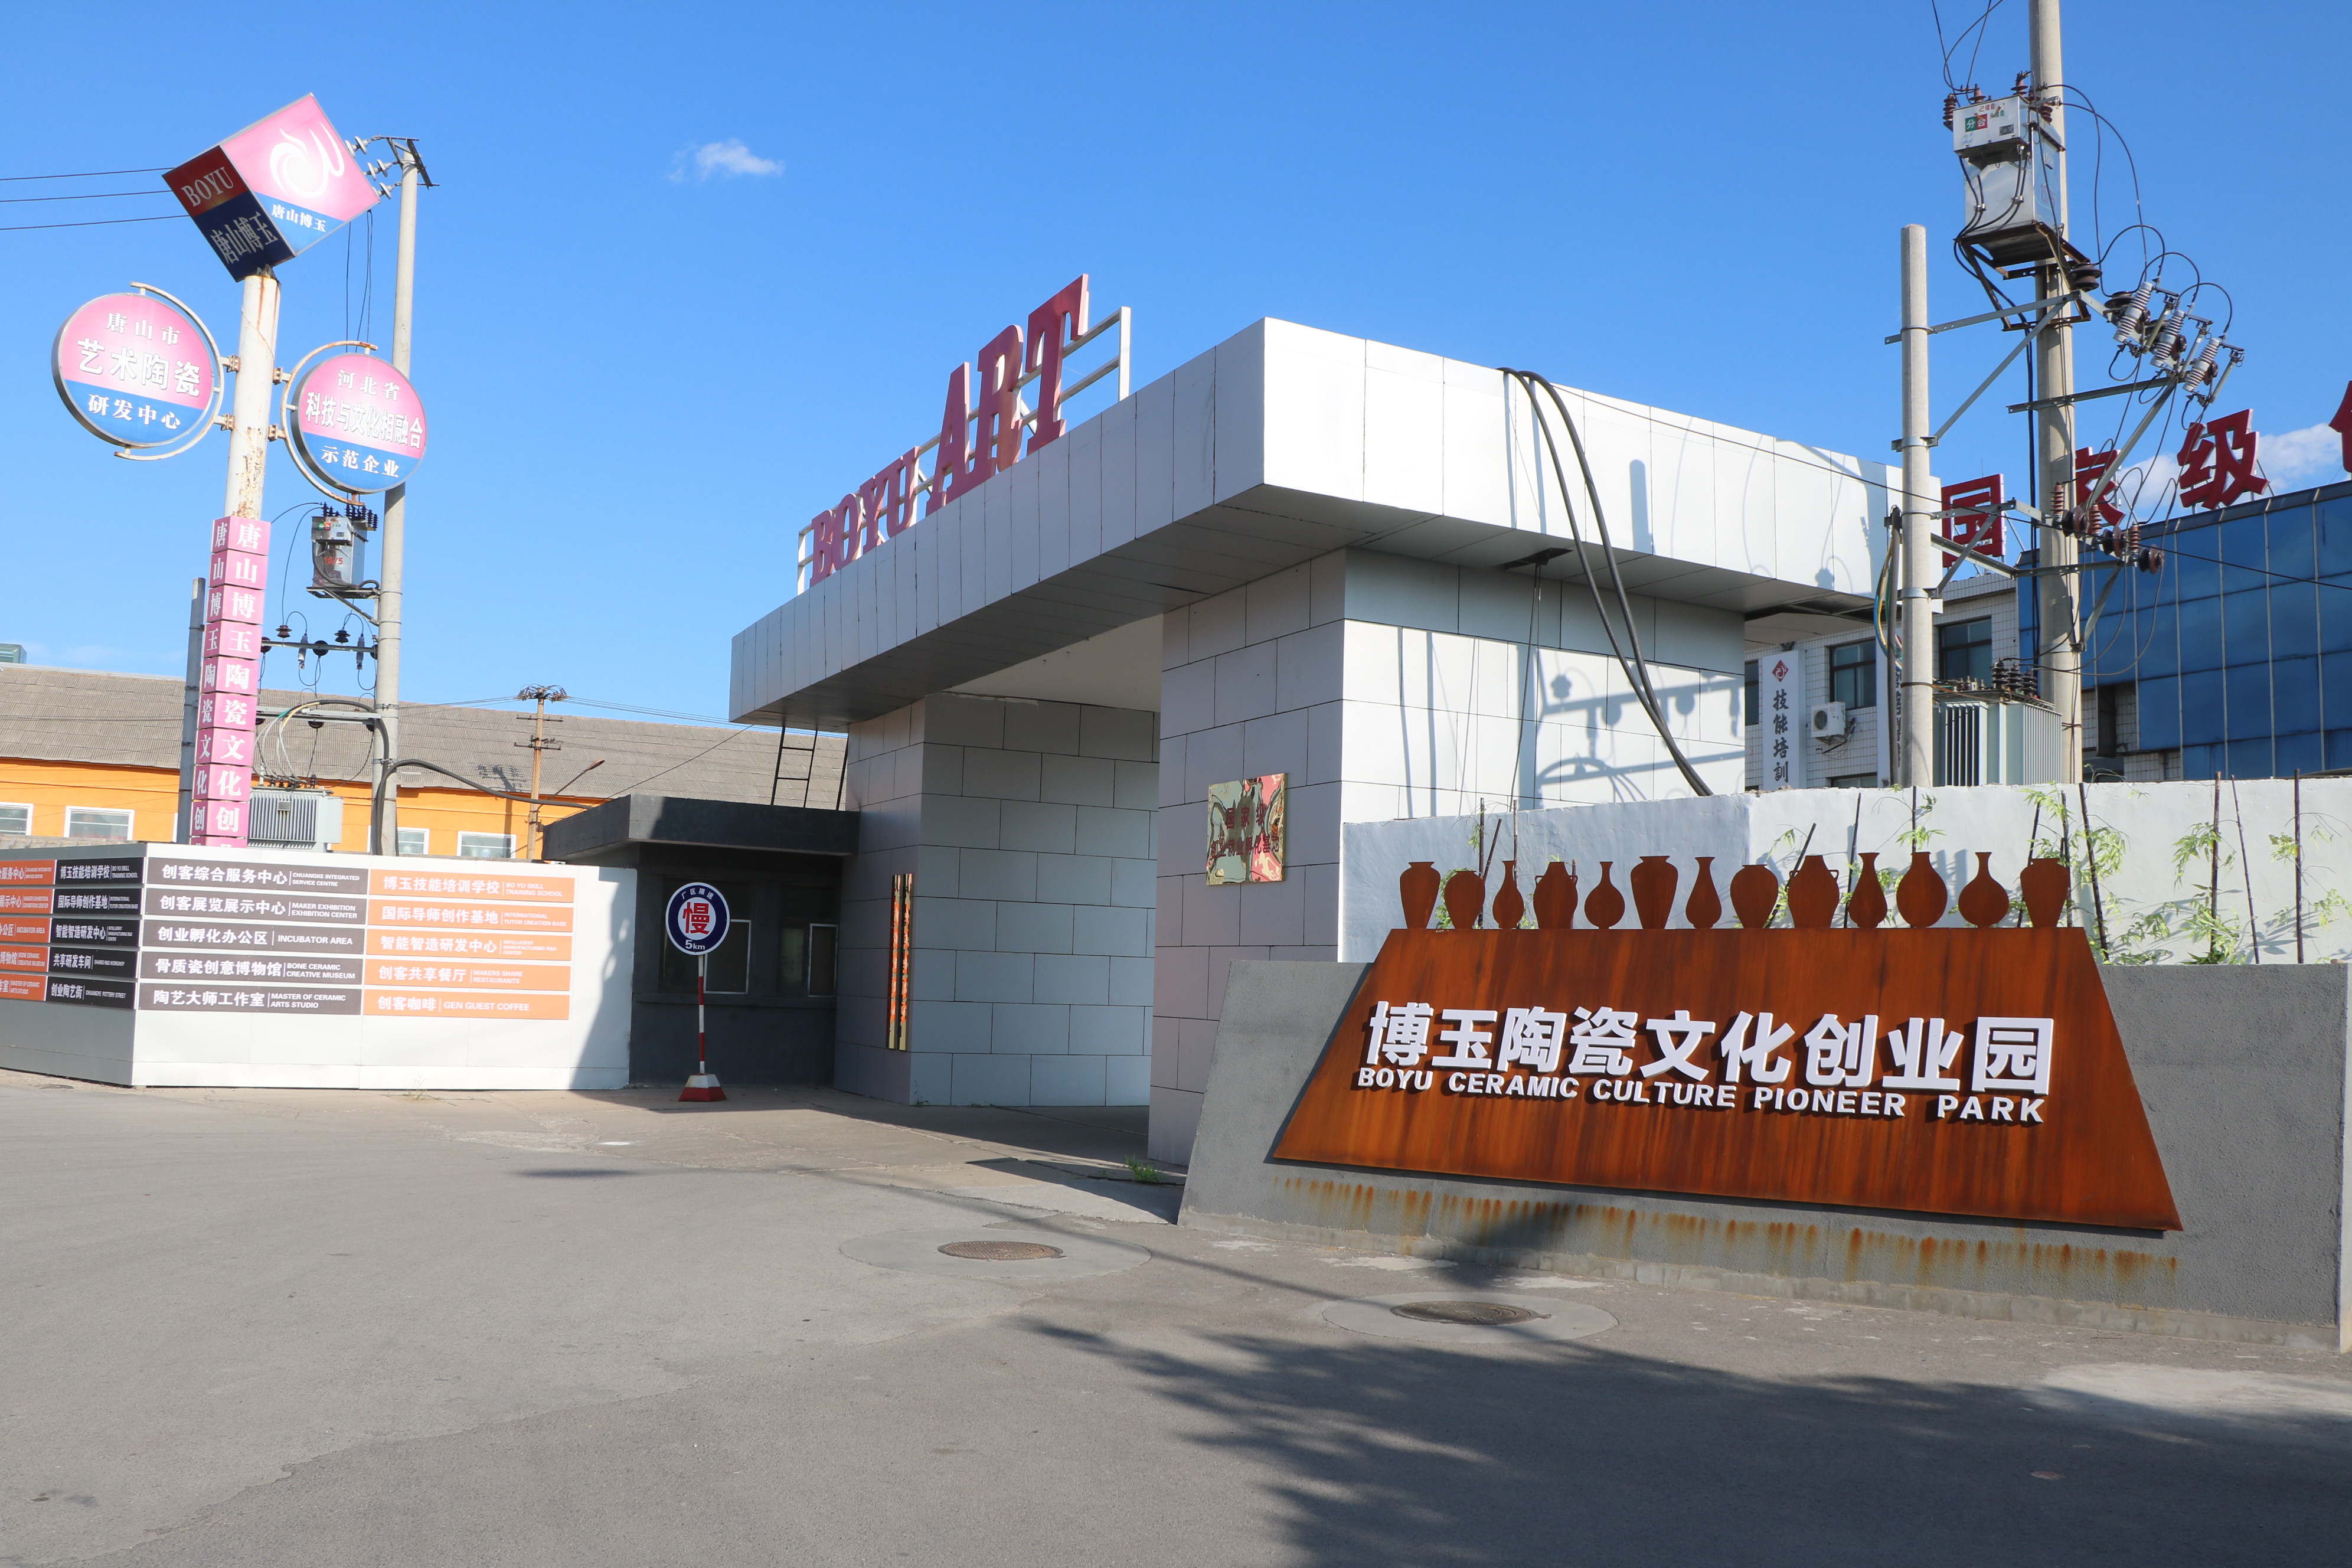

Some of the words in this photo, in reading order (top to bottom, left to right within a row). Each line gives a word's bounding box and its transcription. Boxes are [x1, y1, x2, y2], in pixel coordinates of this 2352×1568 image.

[181, 166, 235, 207] BOYU
[271, 204, 327, 233] 唐山博玉
[210, 212, 278, 265] 唐山博玉
[106, 312, 181, 346] 唐山市
[77, 338, 201, 397] 艺术陶瓷
[338, 369, 400, 401] 河北省
[88, 394, 181, 430] 研发中心
[305, 390, 423, 450] 科技与文化相融合
[810, 446, 920, 587] BOYU
[926, 274, 1089, 517] ART
[321, 445, 400, 478] 示范企业
[194, 522, 227, 845] 唐山博玉陶瓷文化创
[215, 523, 262, 847] 唐山博玉陶瓷文化创
[1226, 803, 1266, 829] 国家级
[1211, 833, 1279, 860] 创业就业孵化基地
[60, 865, 110, 879] 博玉技能培训学校
[162, 864, 288, 885] 创客综合服务中心
[383, 876, 500, 894] 博玉技能培训学校
[681, 888, 714, 899] 厂区限速
[58, 894, 108, 909] 国际导师创作基地
[160, 895, 286, 915] 创客展览展示中心
[382, 906, 499, 924] 国际导师创作基地
[682, 902, 710, 935] 慢
[0, 923, 14, 936] 公区
[55, 924, 106, 940] 智能智造研发中心
[158, 926, 268, 945] 创业孵化办公区
[277, 935, 328, 944] INCUBATOR
[380, 935, 497, 953] 智能智造研发中心
[685, 940, 705, 950] 5km
[54, 953, 92, 969] 共享研发车间
[156, 958, 282, 977] 骨质瓷创意博物馆
[378, 966, 466, 982] 创客共享餐厅
[51, 983, 83, 999] 创业陶艺街
[153, 989, 265, 1007] 陶艺大师工作室
[377, 996, 436, 1011] 创客咖啡
[465, 1002, 495, 1010] GUEST
[1366, 1001, 2054, 1096] 博玉陶瓷文化创业园
[1358, 1067, 1433, 1091] BOYU
[1448, 1072, 1579, 1099] CERAMIC
[1593, 1078, 1737, 1108] CULTURE
[1753, 1086, 1906, 1117] PIONEER
[1937, 1095, 2045, 1123] PARK
